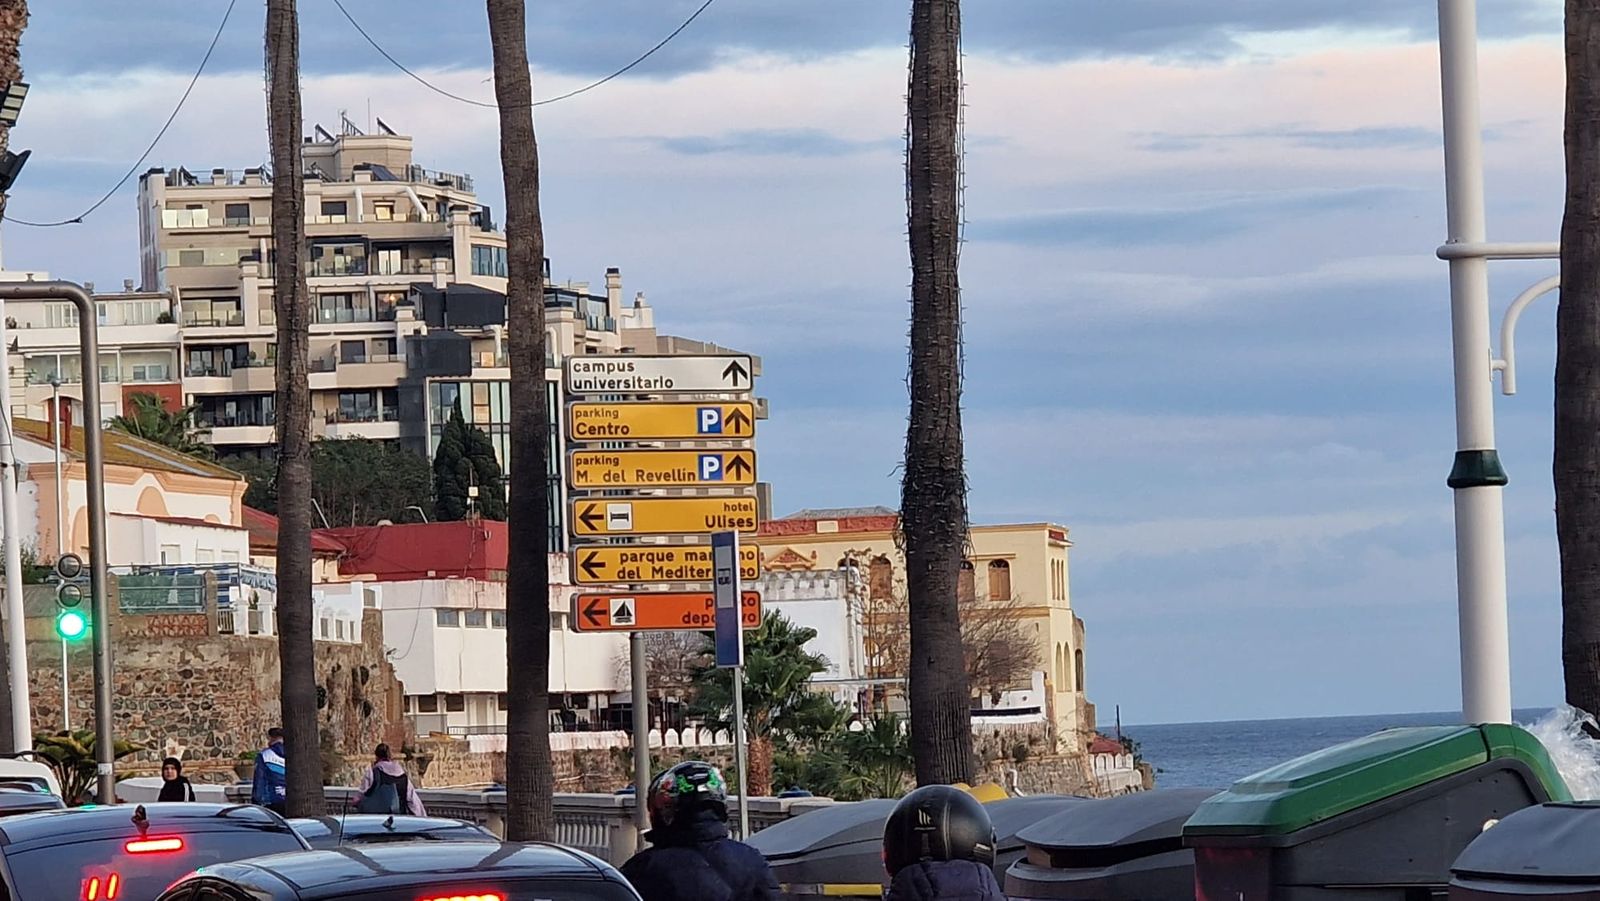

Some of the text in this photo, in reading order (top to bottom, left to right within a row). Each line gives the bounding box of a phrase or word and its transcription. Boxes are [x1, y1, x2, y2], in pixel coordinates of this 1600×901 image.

[573, 361, 635, 375] campus
[573, 375, 674, 390] universitario
[575, 407, 619, 420] parking
[702, 409, 719, 432] P
[575, 422, 630, 436] Centro
[575, 455, 620, 467] parking
[702, 456, 720, 480] P
[576, 470, 593, 483] M.
[602, 469, 627, 483] del
[723, 501, 753, 512] hotel
[705, 515, 754, 529] Ulises
[620, 551, 674, 565] parque
[617, 565, 756, 580] del Meditereo
